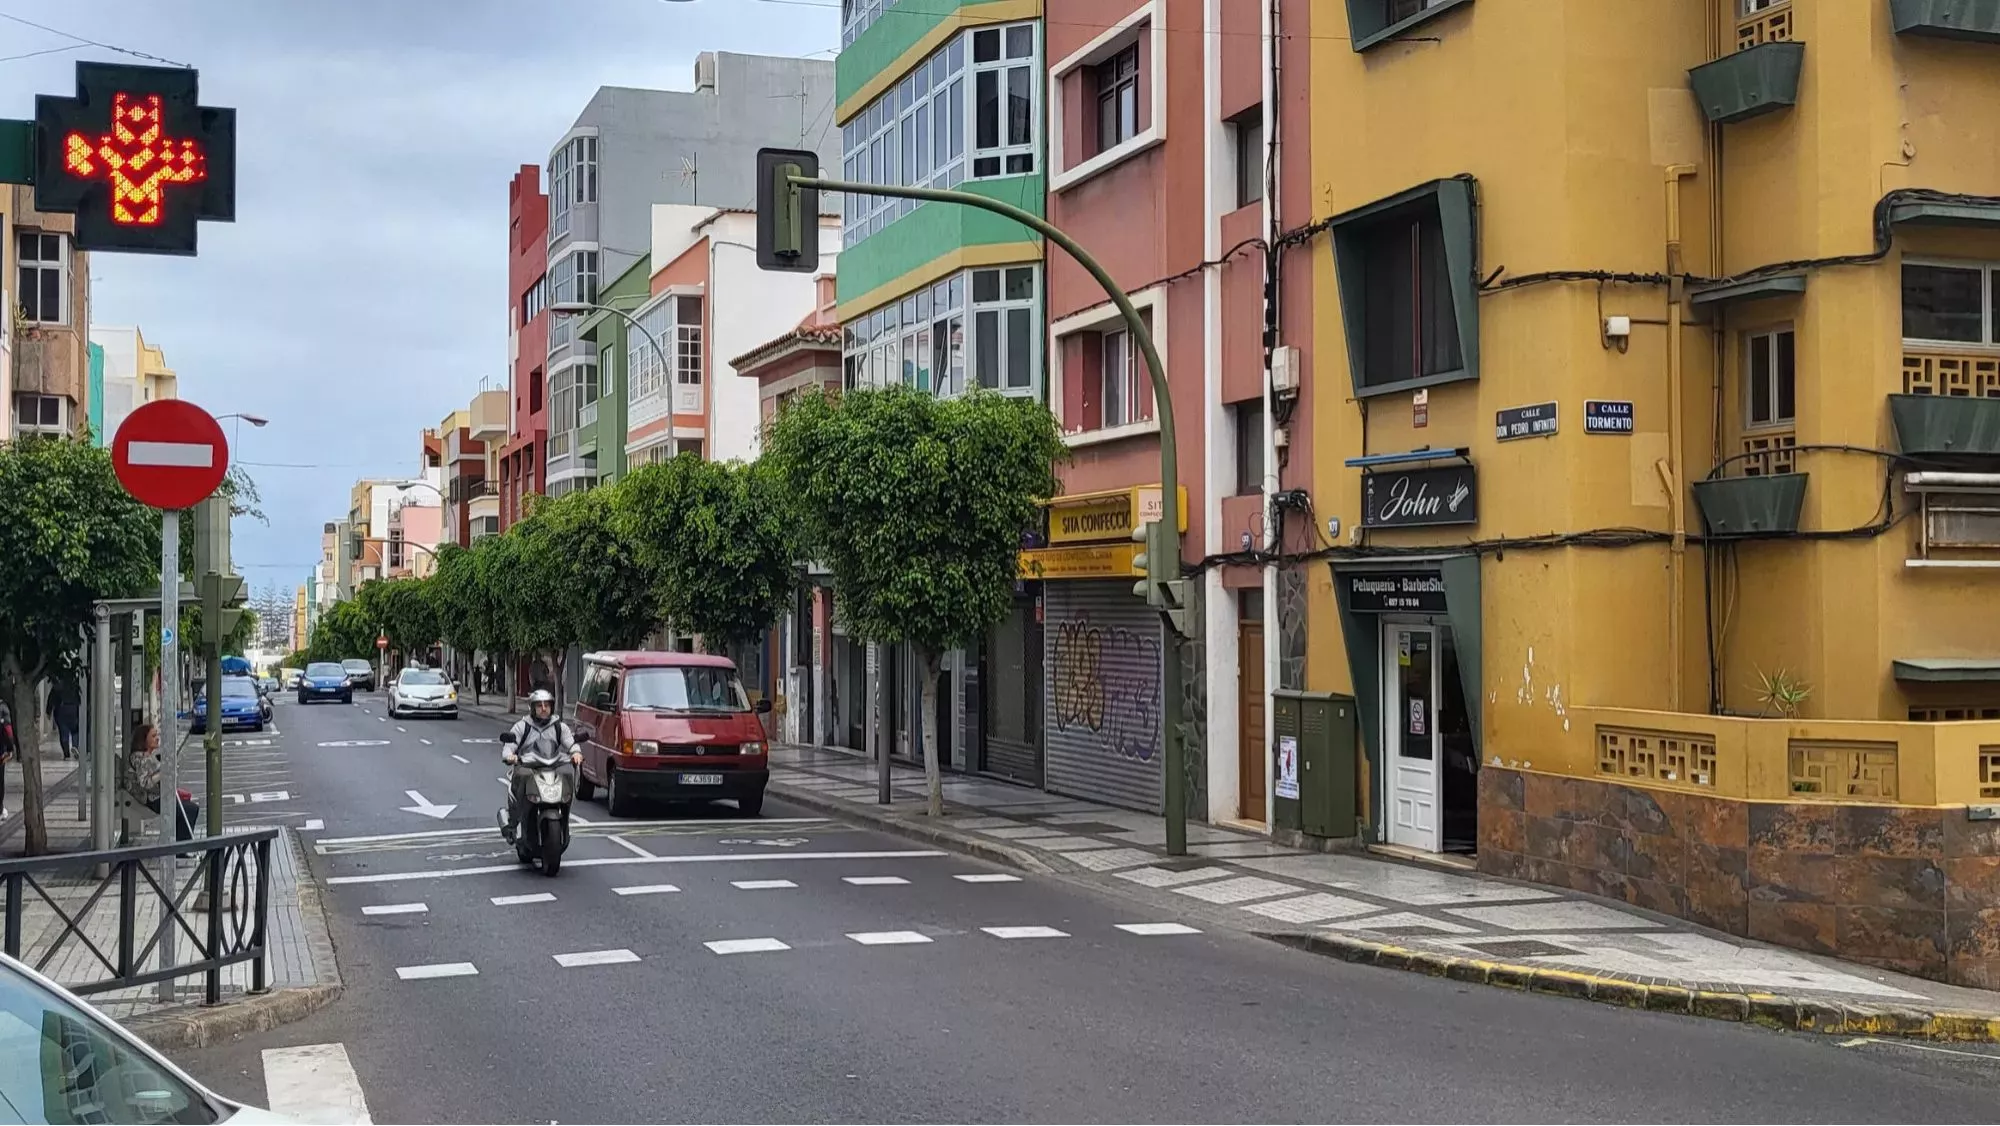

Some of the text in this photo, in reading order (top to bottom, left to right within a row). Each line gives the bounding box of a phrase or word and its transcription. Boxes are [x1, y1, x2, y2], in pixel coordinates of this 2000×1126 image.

[1521, 408, 1541, 419] CALLE
[1601, 405, 1629, 414] CALLE
[1496, 418, 1556, 437] DON PEDRO INFINITO
[1587, 416, 1632, 430] TORMENTO
[1380, 476, 1441, 521] John
